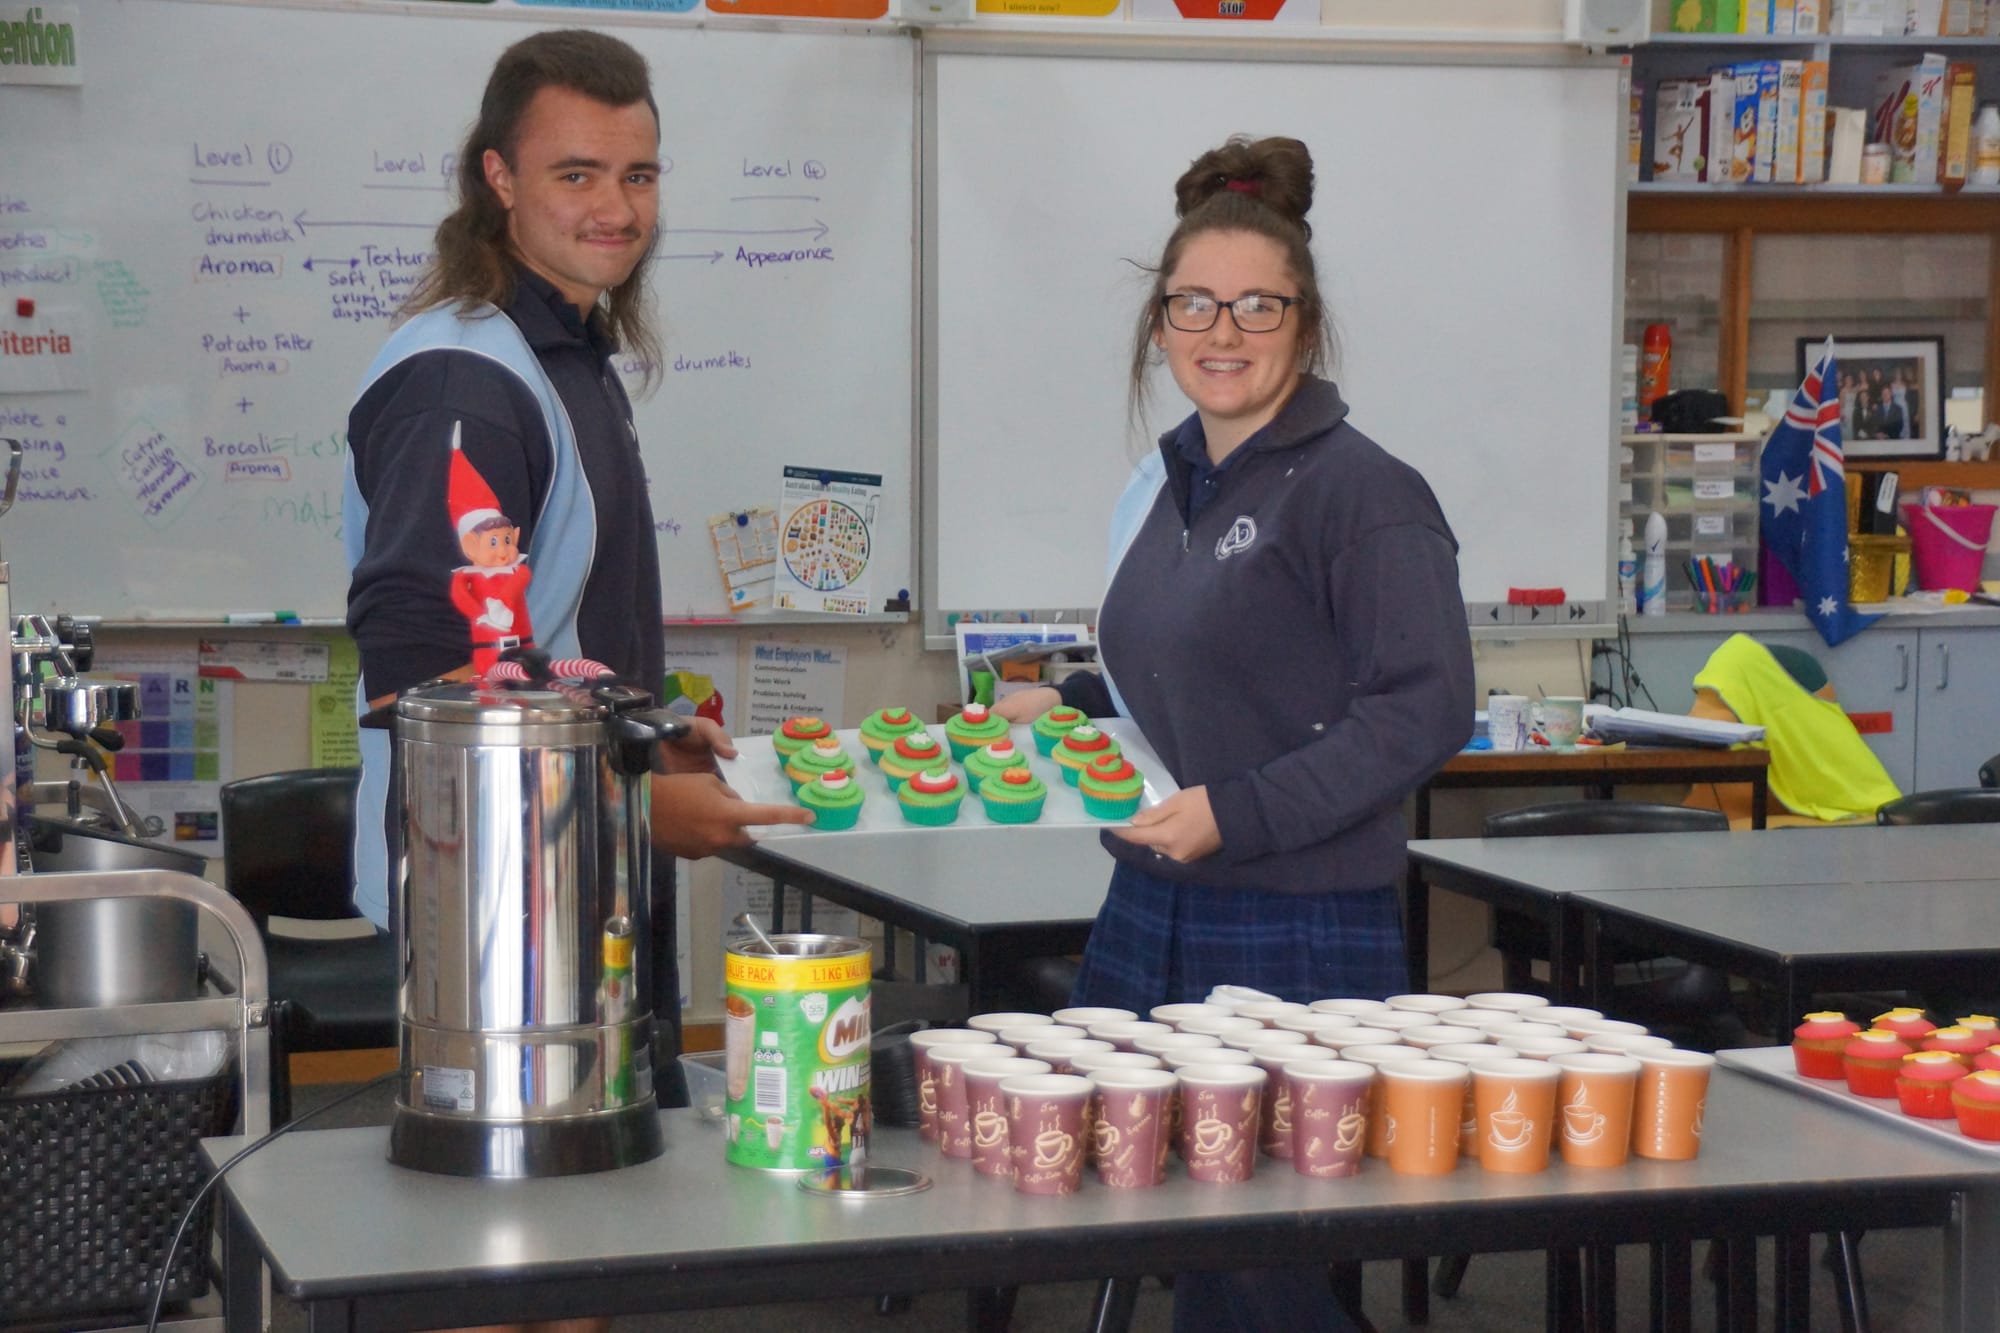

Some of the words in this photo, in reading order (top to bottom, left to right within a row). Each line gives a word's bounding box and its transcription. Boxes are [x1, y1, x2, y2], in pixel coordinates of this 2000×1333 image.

[1219, 1, 1246, 16] STOP
[193, 141, 253, 168] Level
[373, 150, 427, 173] Level
[743, 157, 792, 178] Level
[192, 201, 284, 223] Chicken
[200, 254, 275, 275] Aroma
[735, 246, 834, 267] Appearance
[202, 333, 267, 352] Potato
[204, 432, 272, 457] Brocoli
[754, 663, 807, 673] Communication
[175, 679, 190, 694] R
[200, 679, 215, 694] N
[753, 689, 781, 698] Problem
[748, 966, 775, 981] PACK
[816, 1064, 860, 1093] WIN
